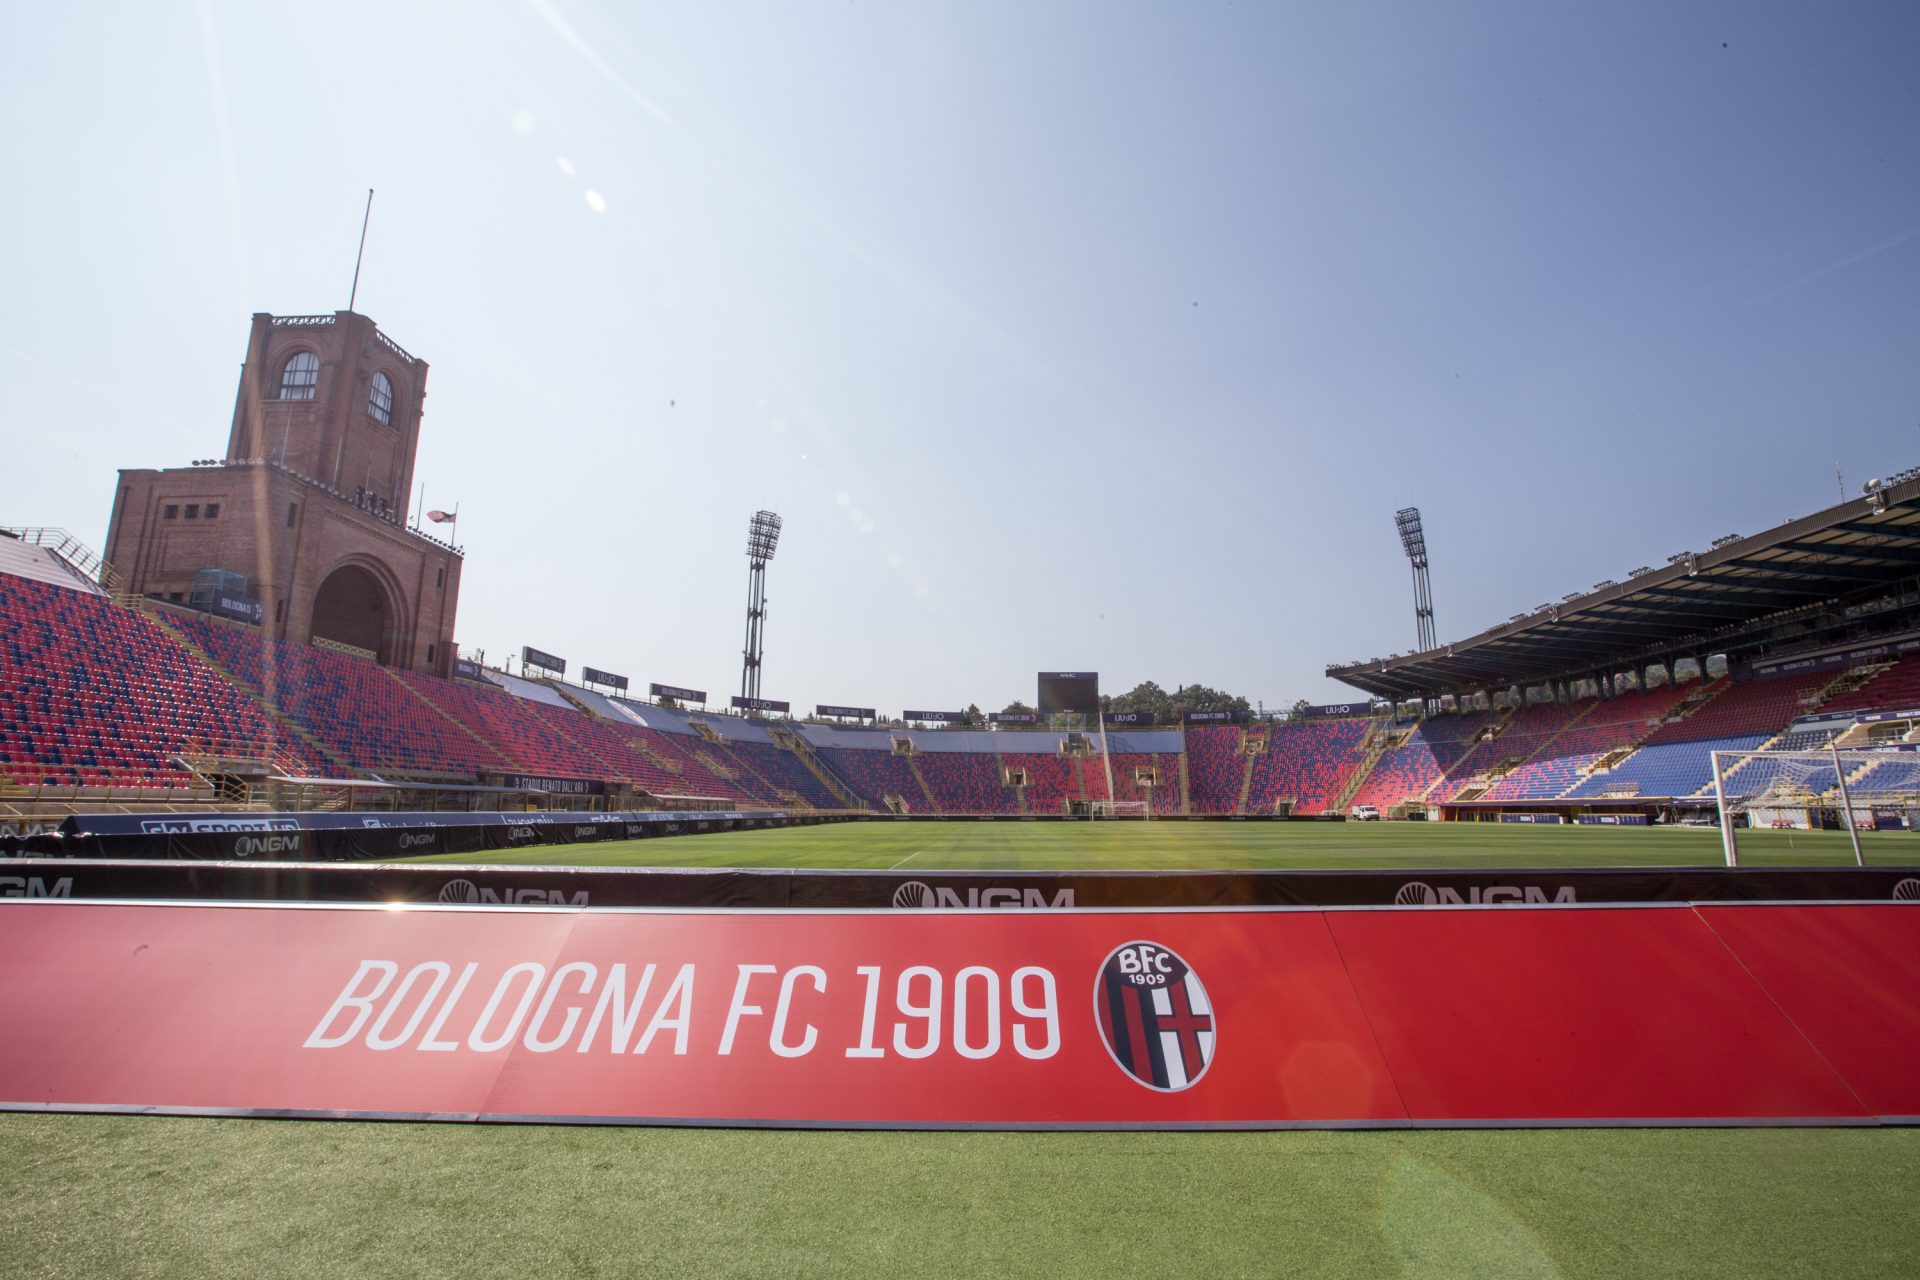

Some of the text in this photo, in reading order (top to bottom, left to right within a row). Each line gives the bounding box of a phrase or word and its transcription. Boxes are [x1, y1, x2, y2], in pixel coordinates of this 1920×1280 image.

[221, 598, 247, 613] BOLOGNA
[250, 836, 300, 853] NGM
[935, 887, 1075, 907] NGM
[1436, 886, 1577, 904] NGM
[1117, 945, 1173, 974] BFC
[1128, 973, 1166, 985] 1909
[302, 959, 1062, 1061] BOLOGNA FC 1909
